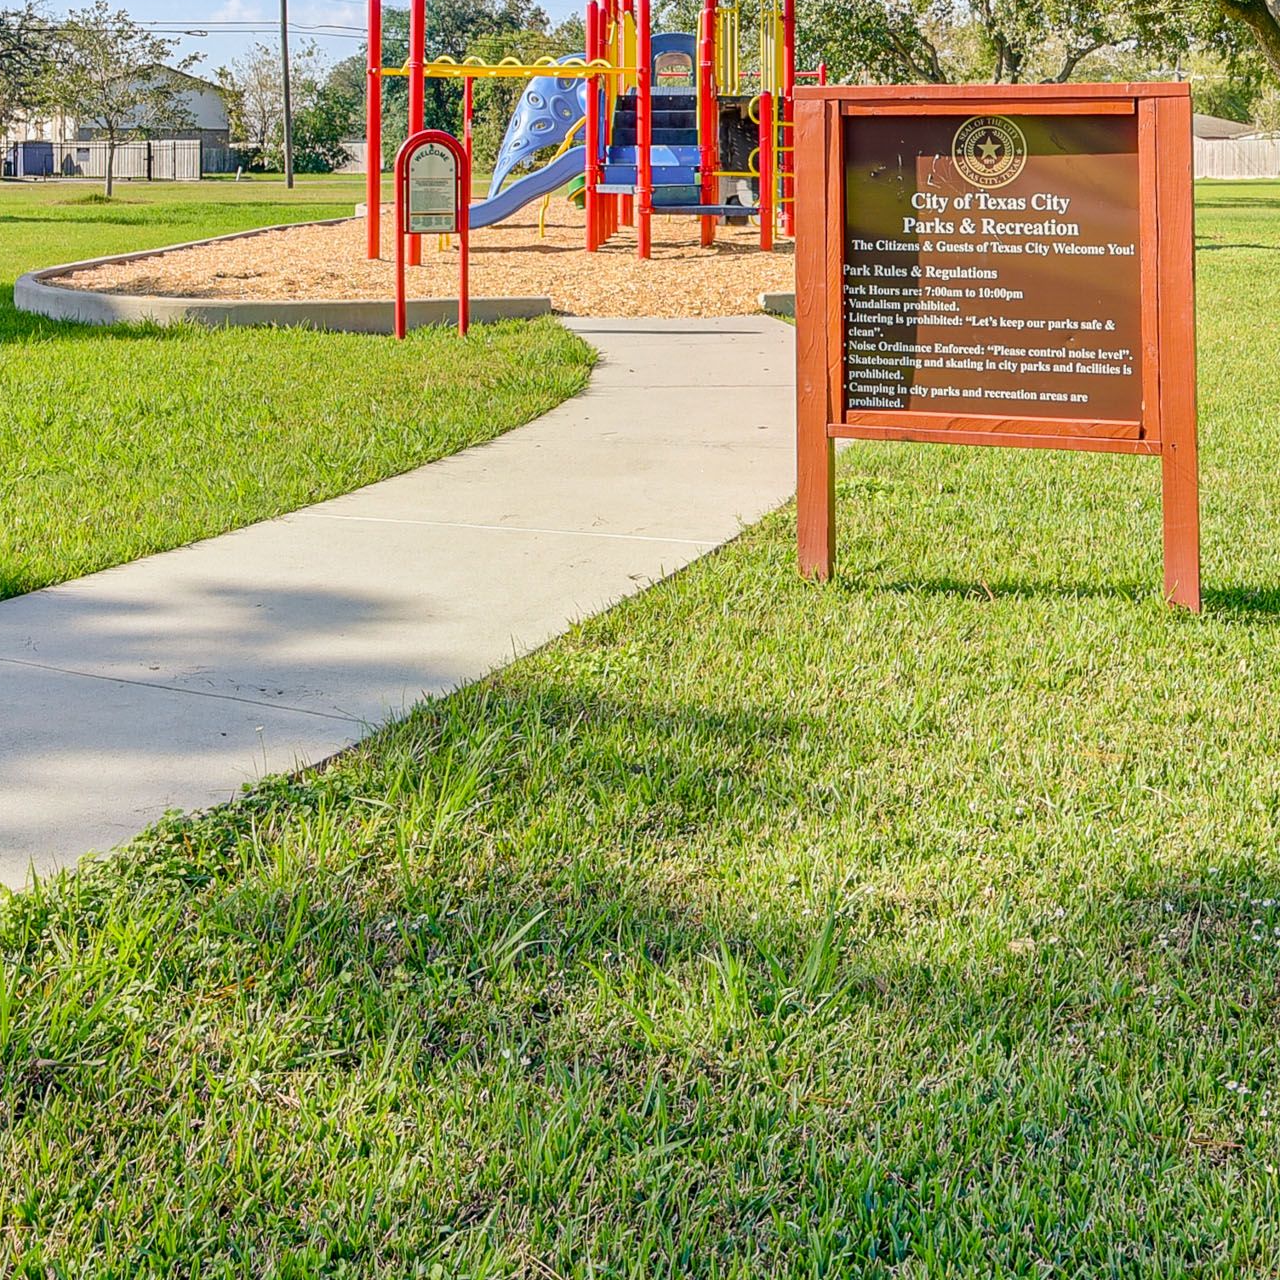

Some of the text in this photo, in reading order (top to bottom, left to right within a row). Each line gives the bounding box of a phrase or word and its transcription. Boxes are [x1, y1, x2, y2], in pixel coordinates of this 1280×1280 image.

[959, 123, 974, 141] SEAL
[986, 118, 1003, 126] THE
[1003, 123, 1020, 140] CITY
[414, 149, 450, 162] WELCOME
[958, 158, 1021, 185] TEXAS CITY, TEXAS
[911, 192, 1070, 214] City of Texas City
[903, 217, 1079, 236] Parks & Recreation
[852, 239, 1135, 256] The Citizens & Guests of Texas City Welcome You!
[843, 264, 998, 280] Park Rules & Regulations
[843, 284, 1024, 301] Park Hours are: 7:00am to 10:00pm
[849, 298, 960, 312] Vandalism prohibited.
[849, 312, 893, 325] Littering
[896, 314, 904, 324] is
[906, 314, 963, 326] prohibited:
[999, 317, 1025, 330] keep
[1026, 320, 1046, 328] our
[1048, 318, 1079, 331] parks
[1080, 320, 1102, 330] safe
[1104, 320, 1115, 331] &
[849, 341, 876, 351] Noise
[878, 342, 932, 353] Ordinance
[934, 343, 985, 355] Enforced:
[1028, 348, 1065, 358] control
[1068, 348, 1096, 359] noise
[849, 354, 1132, 375] Skateboarding and skating in city parks and facilities is
[848, 368, 904, 380] prohibited.
[849, 382, 1088, 402] Camping in city parks and recreation areas are
[848, 397, 905, 408] prohibited.
